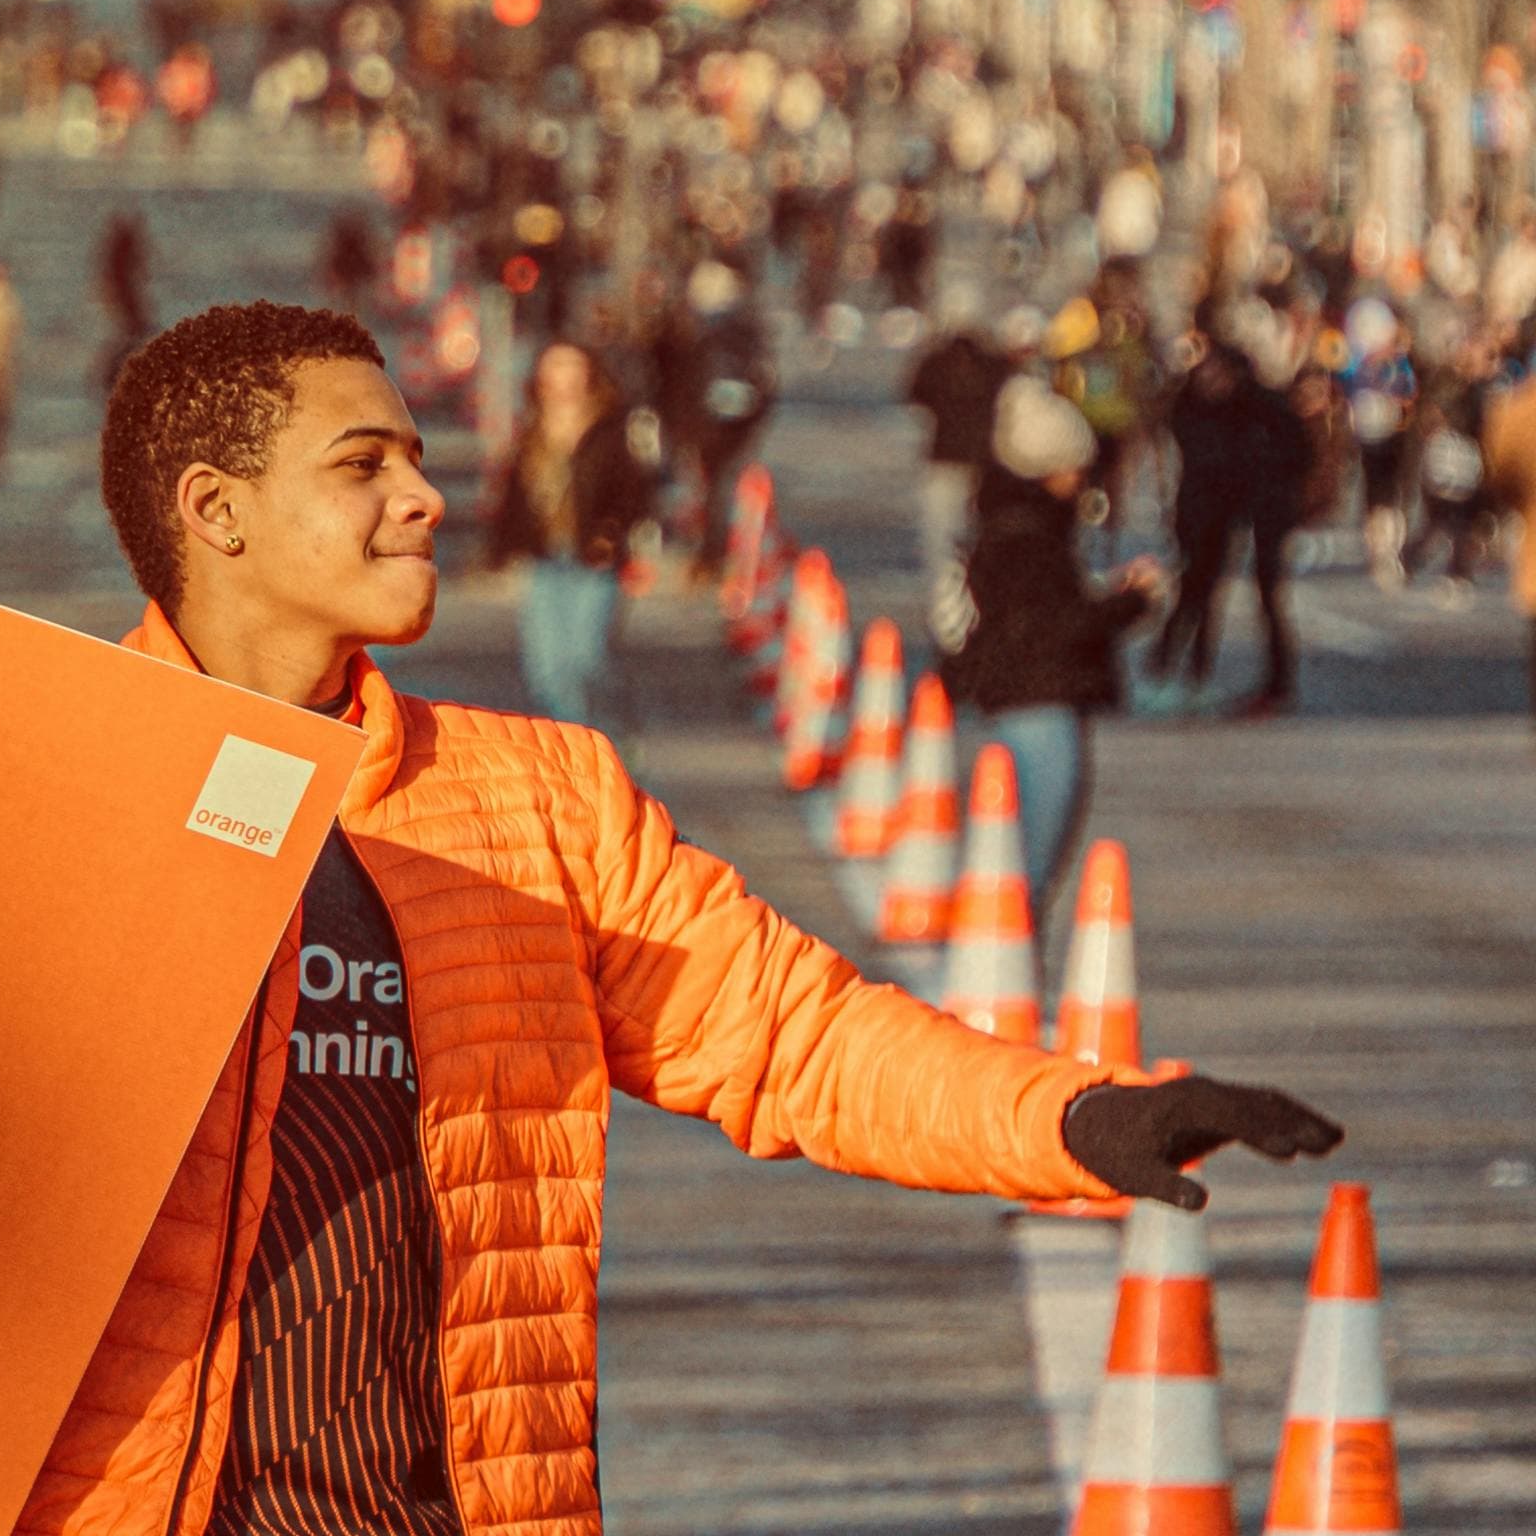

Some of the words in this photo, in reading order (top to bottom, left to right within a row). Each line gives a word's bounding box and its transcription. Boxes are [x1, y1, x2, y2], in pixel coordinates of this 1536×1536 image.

[195, 808, 274, 846] orange
[299, 943, 403, 1004] Ora
[288, 1019, 416, 1093] nnin
